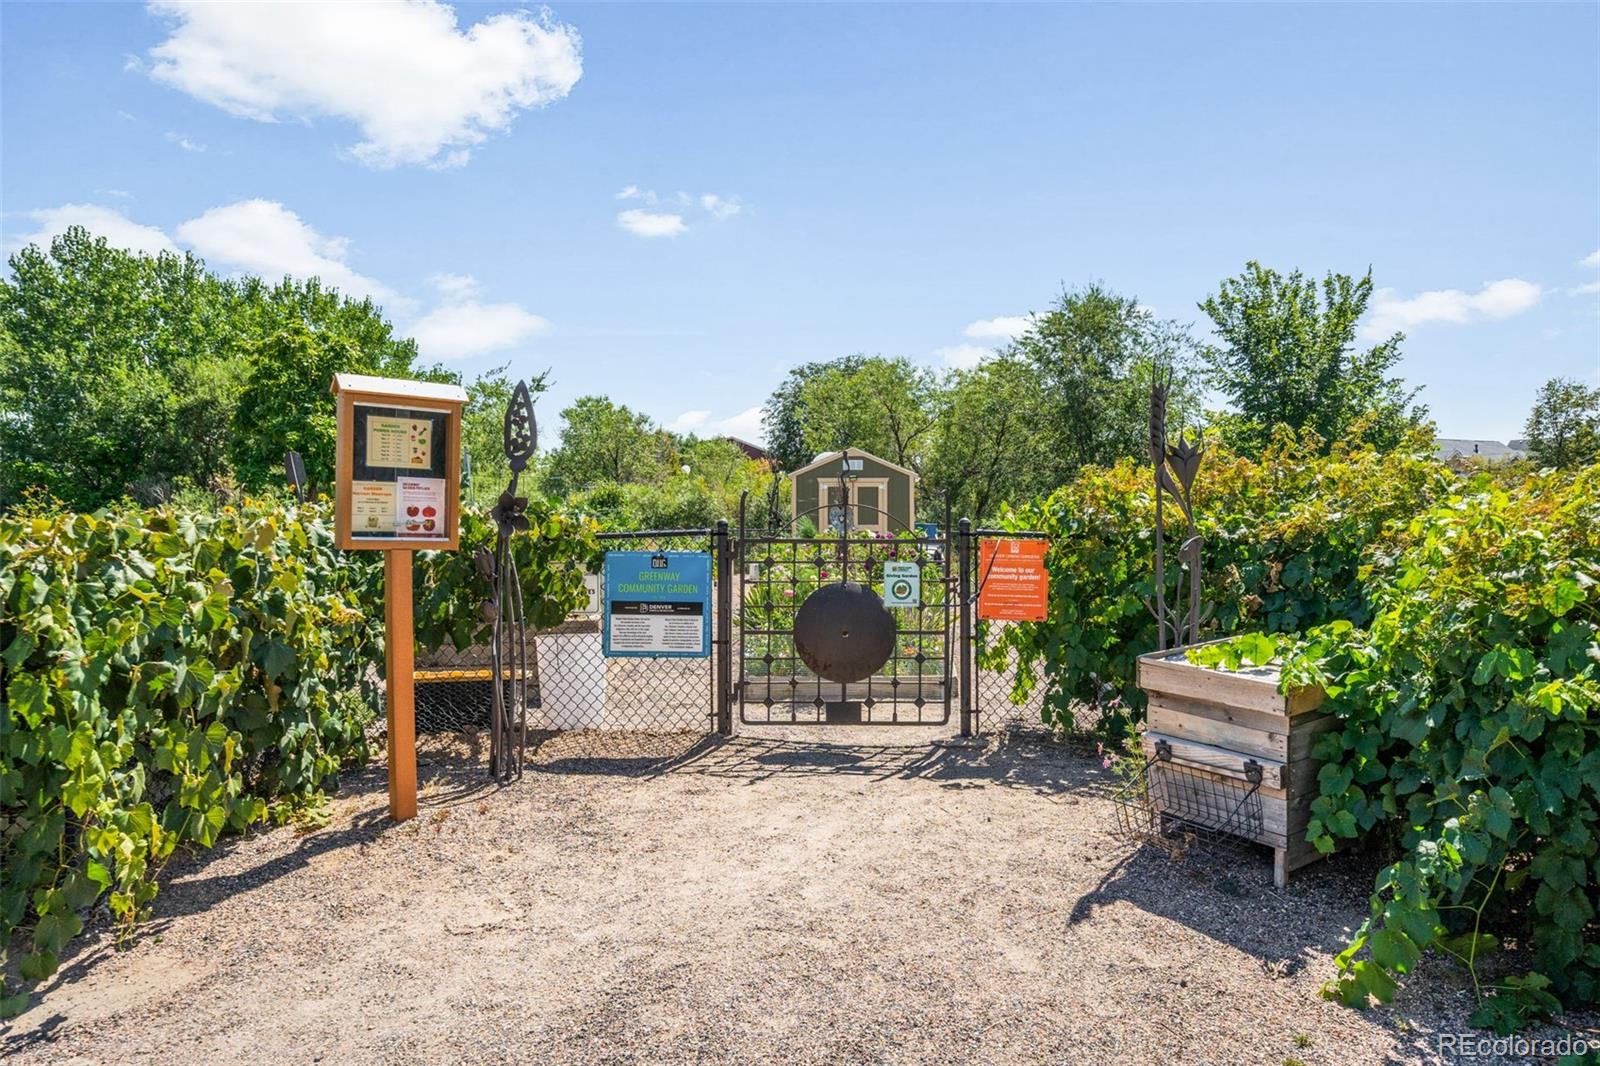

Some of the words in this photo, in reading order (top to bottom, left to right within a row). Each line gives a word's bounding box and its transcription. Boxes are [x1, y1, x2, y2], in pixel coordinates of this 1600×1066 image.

[638, 571, 680, 581] GREENWAY
[618, 584, 666, 593] COMMUNITY
[667, 584, 698, 593] GARDEN
